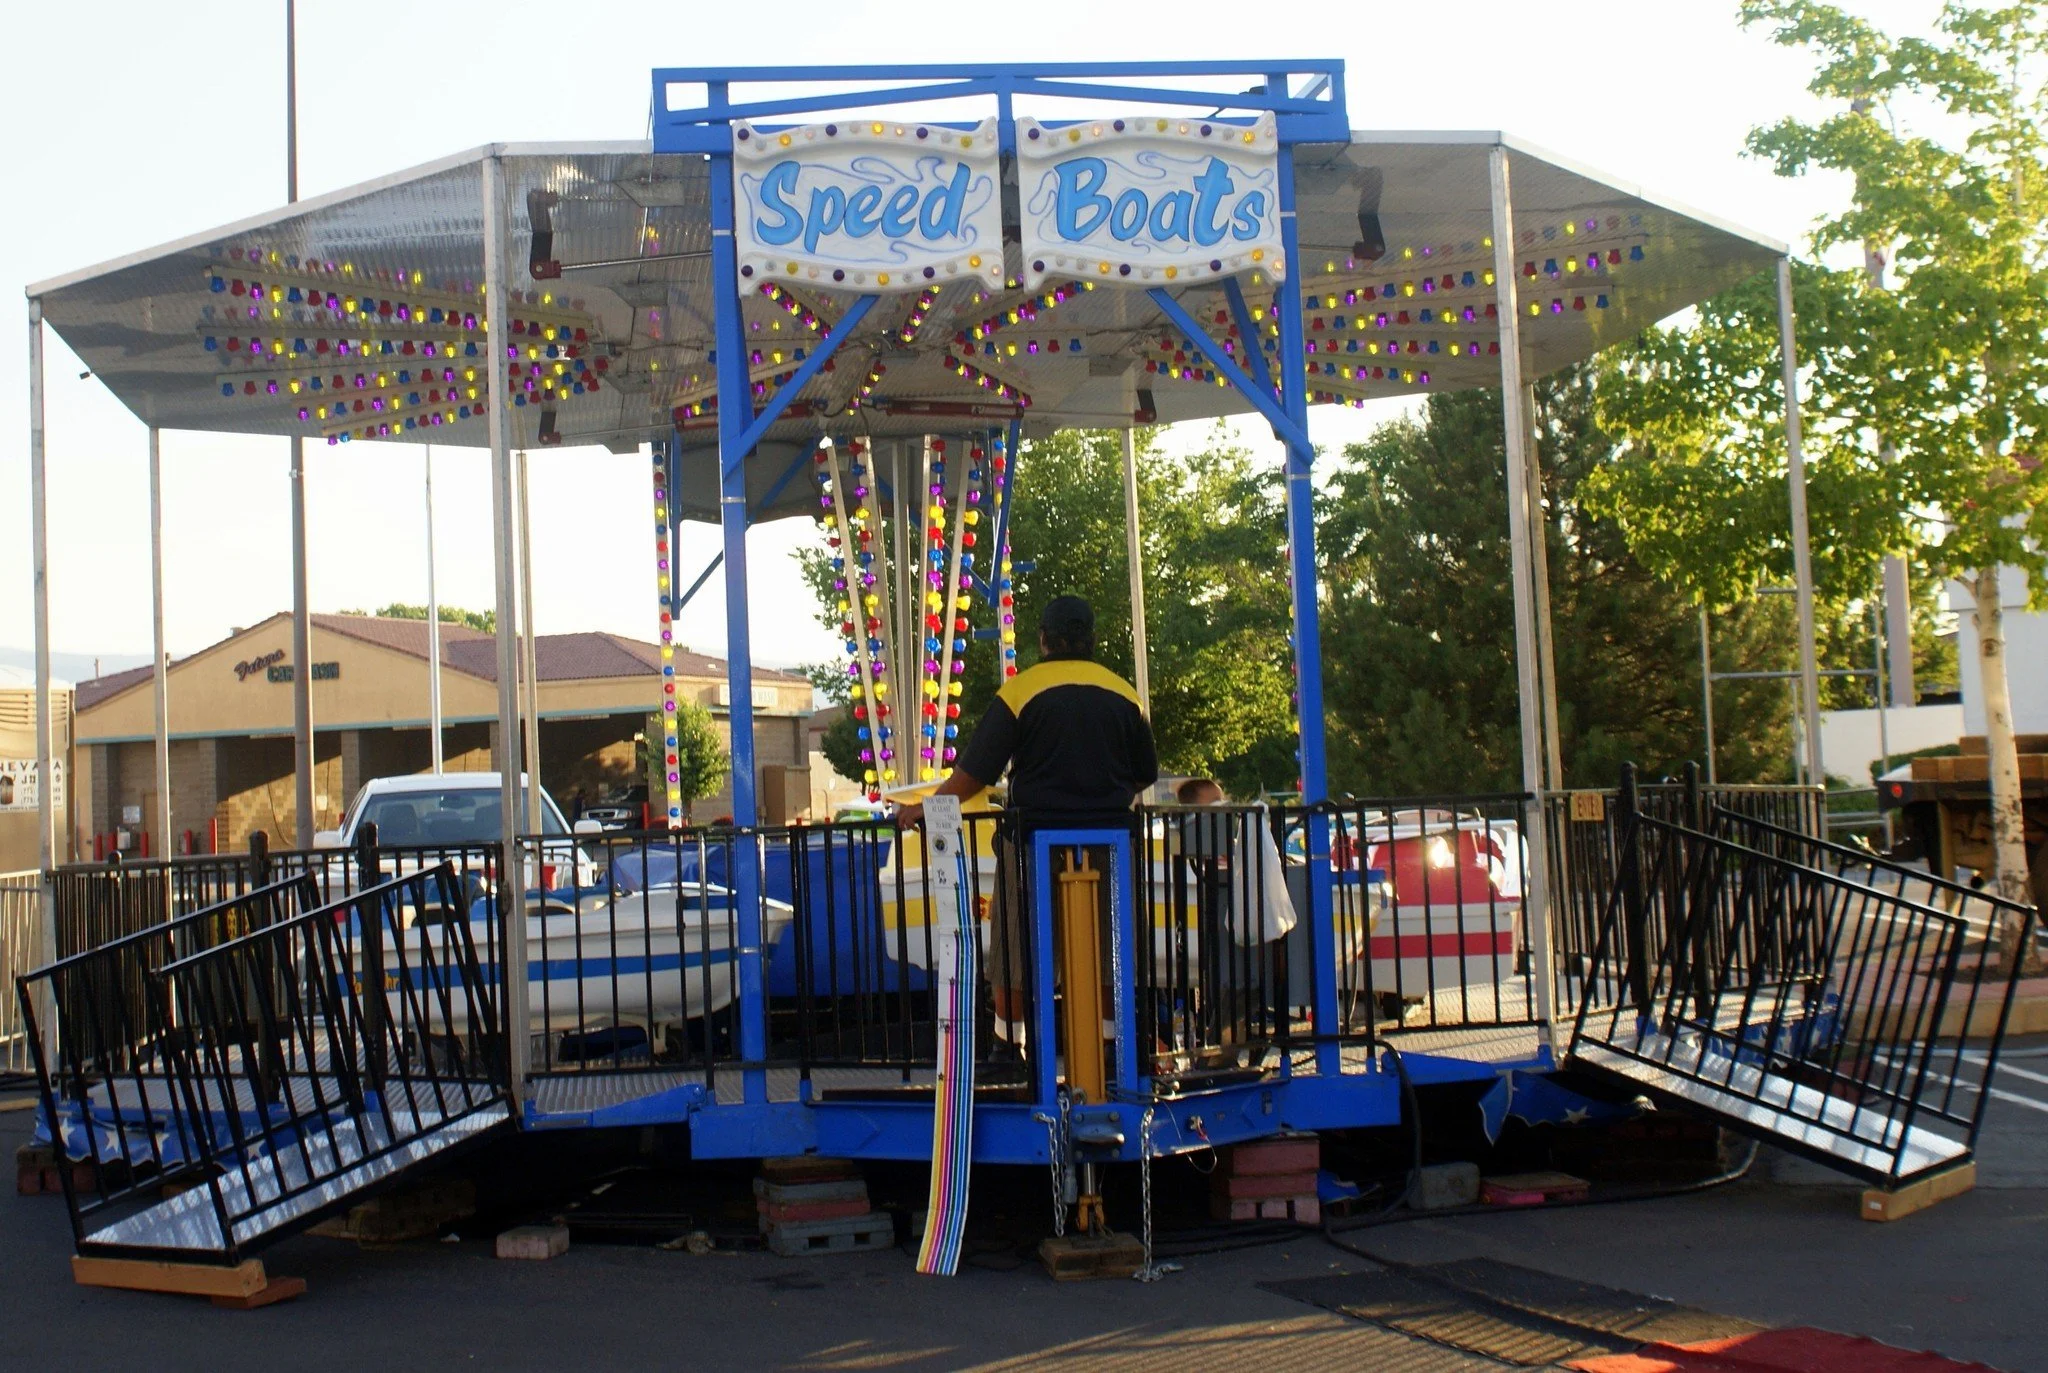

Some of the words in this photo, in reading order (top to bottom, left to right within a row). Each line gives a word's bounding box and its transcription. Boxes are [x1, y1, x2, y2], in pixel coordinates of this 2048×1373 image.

[756, 159, 972, 254] Speed
[1053, 156, 1265, 247] Boats
[311, 661, 340, 681] ASH
[0, 761, 61, 772] NEVAA
